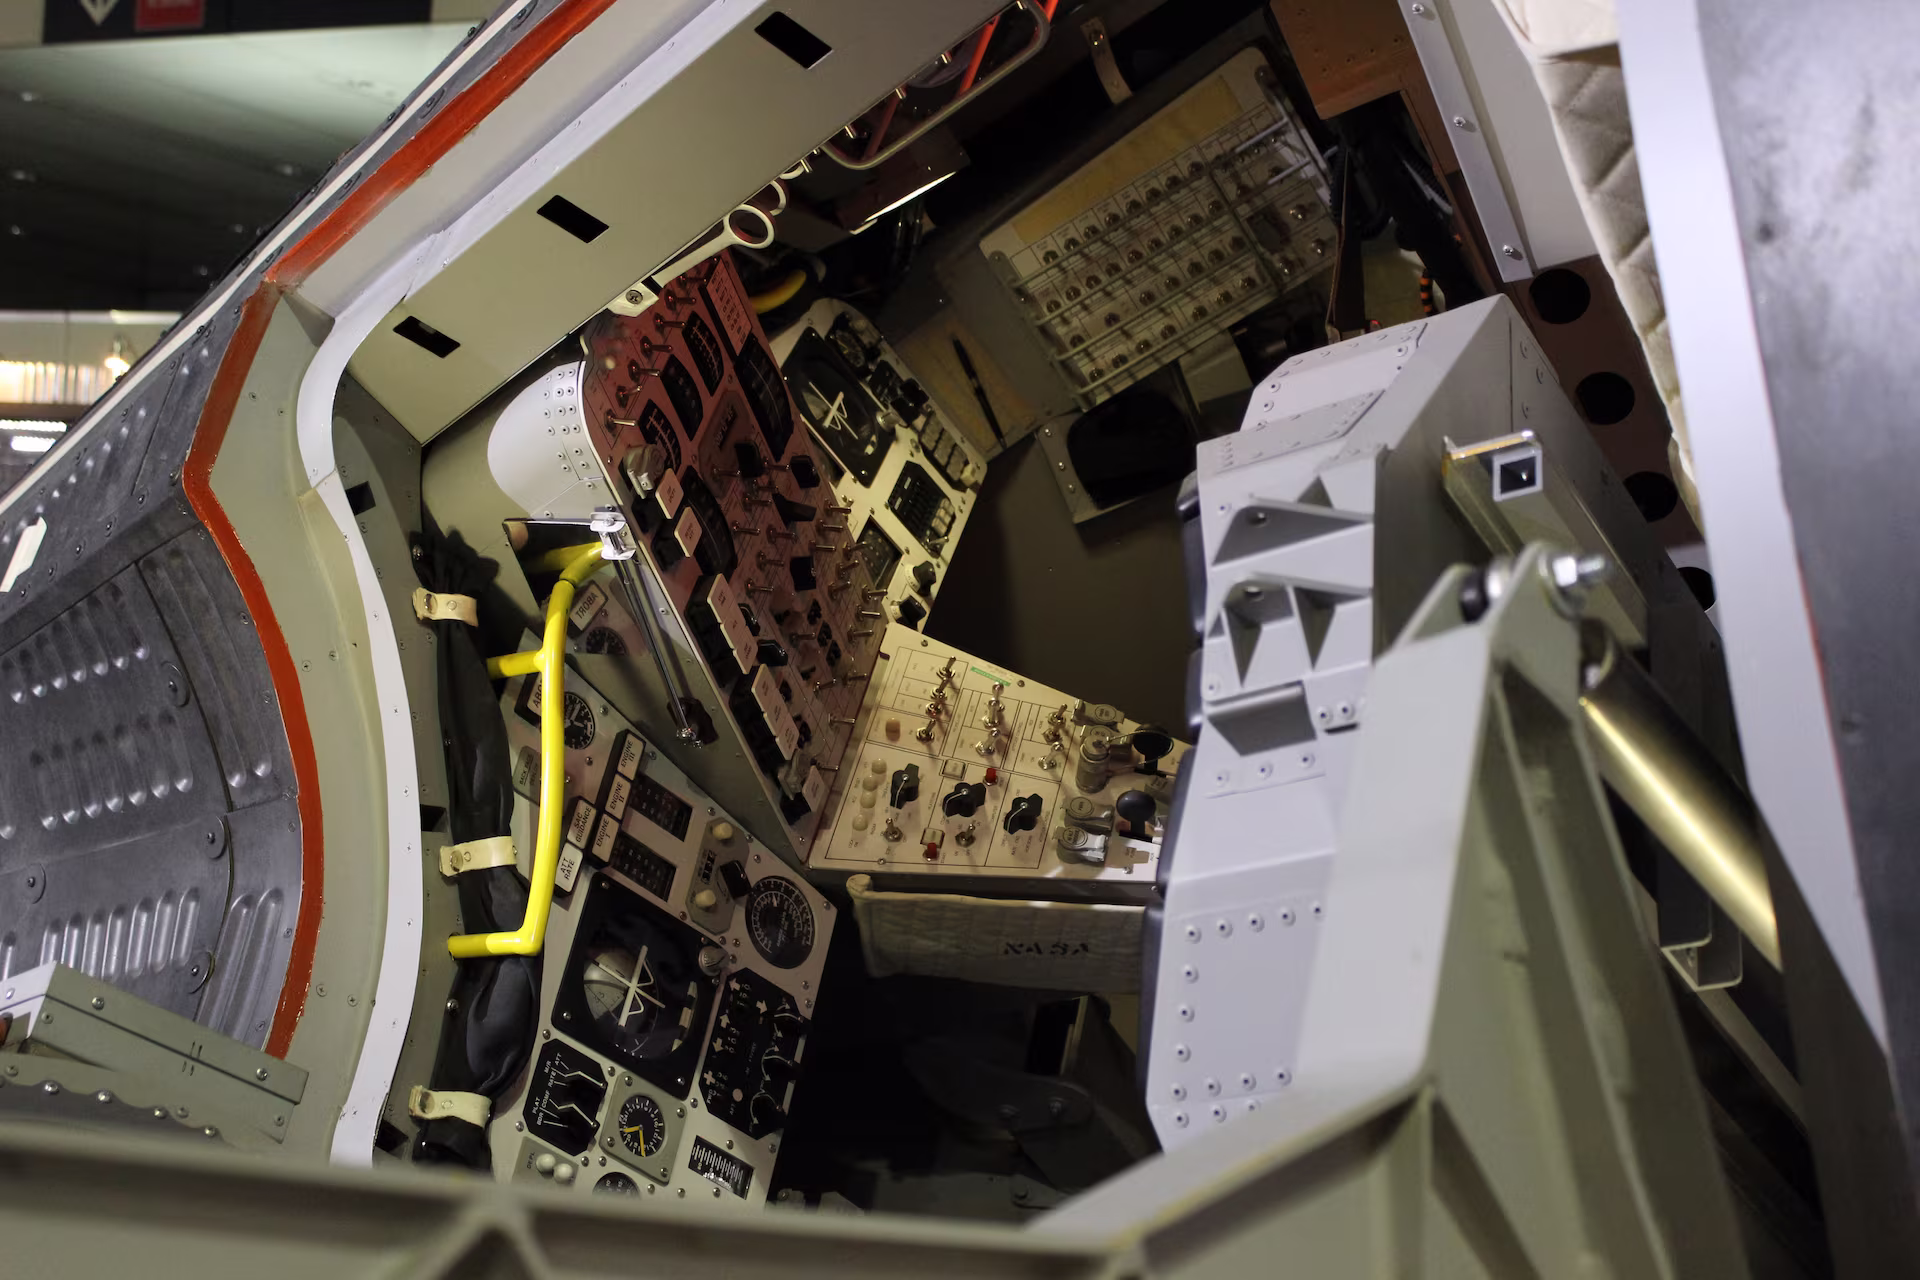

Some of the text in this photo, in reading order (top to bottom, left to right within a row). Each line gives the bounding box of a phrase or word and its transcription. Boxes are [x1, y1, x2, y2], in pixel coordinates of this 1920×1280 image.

[533, 678, 542, 708] ABO
[621, 740, 633, 768] ENGINE
[628, 752, 636, 762] III
[610, 782, 623, 810] ENGINE
[619, 796, 625, 804] II
[576, 807, 592, 842] GUIDANCE
[596, 818, 610, 847] ENGINE
[560, 857, 570, 873] ATT
[564, 860, 575, 880] RATE
[1003, 942, 1089, 956] NASA
[548, 1071, 557, 1088] RATE
[532, 1097, 540, 1114] PLAT
